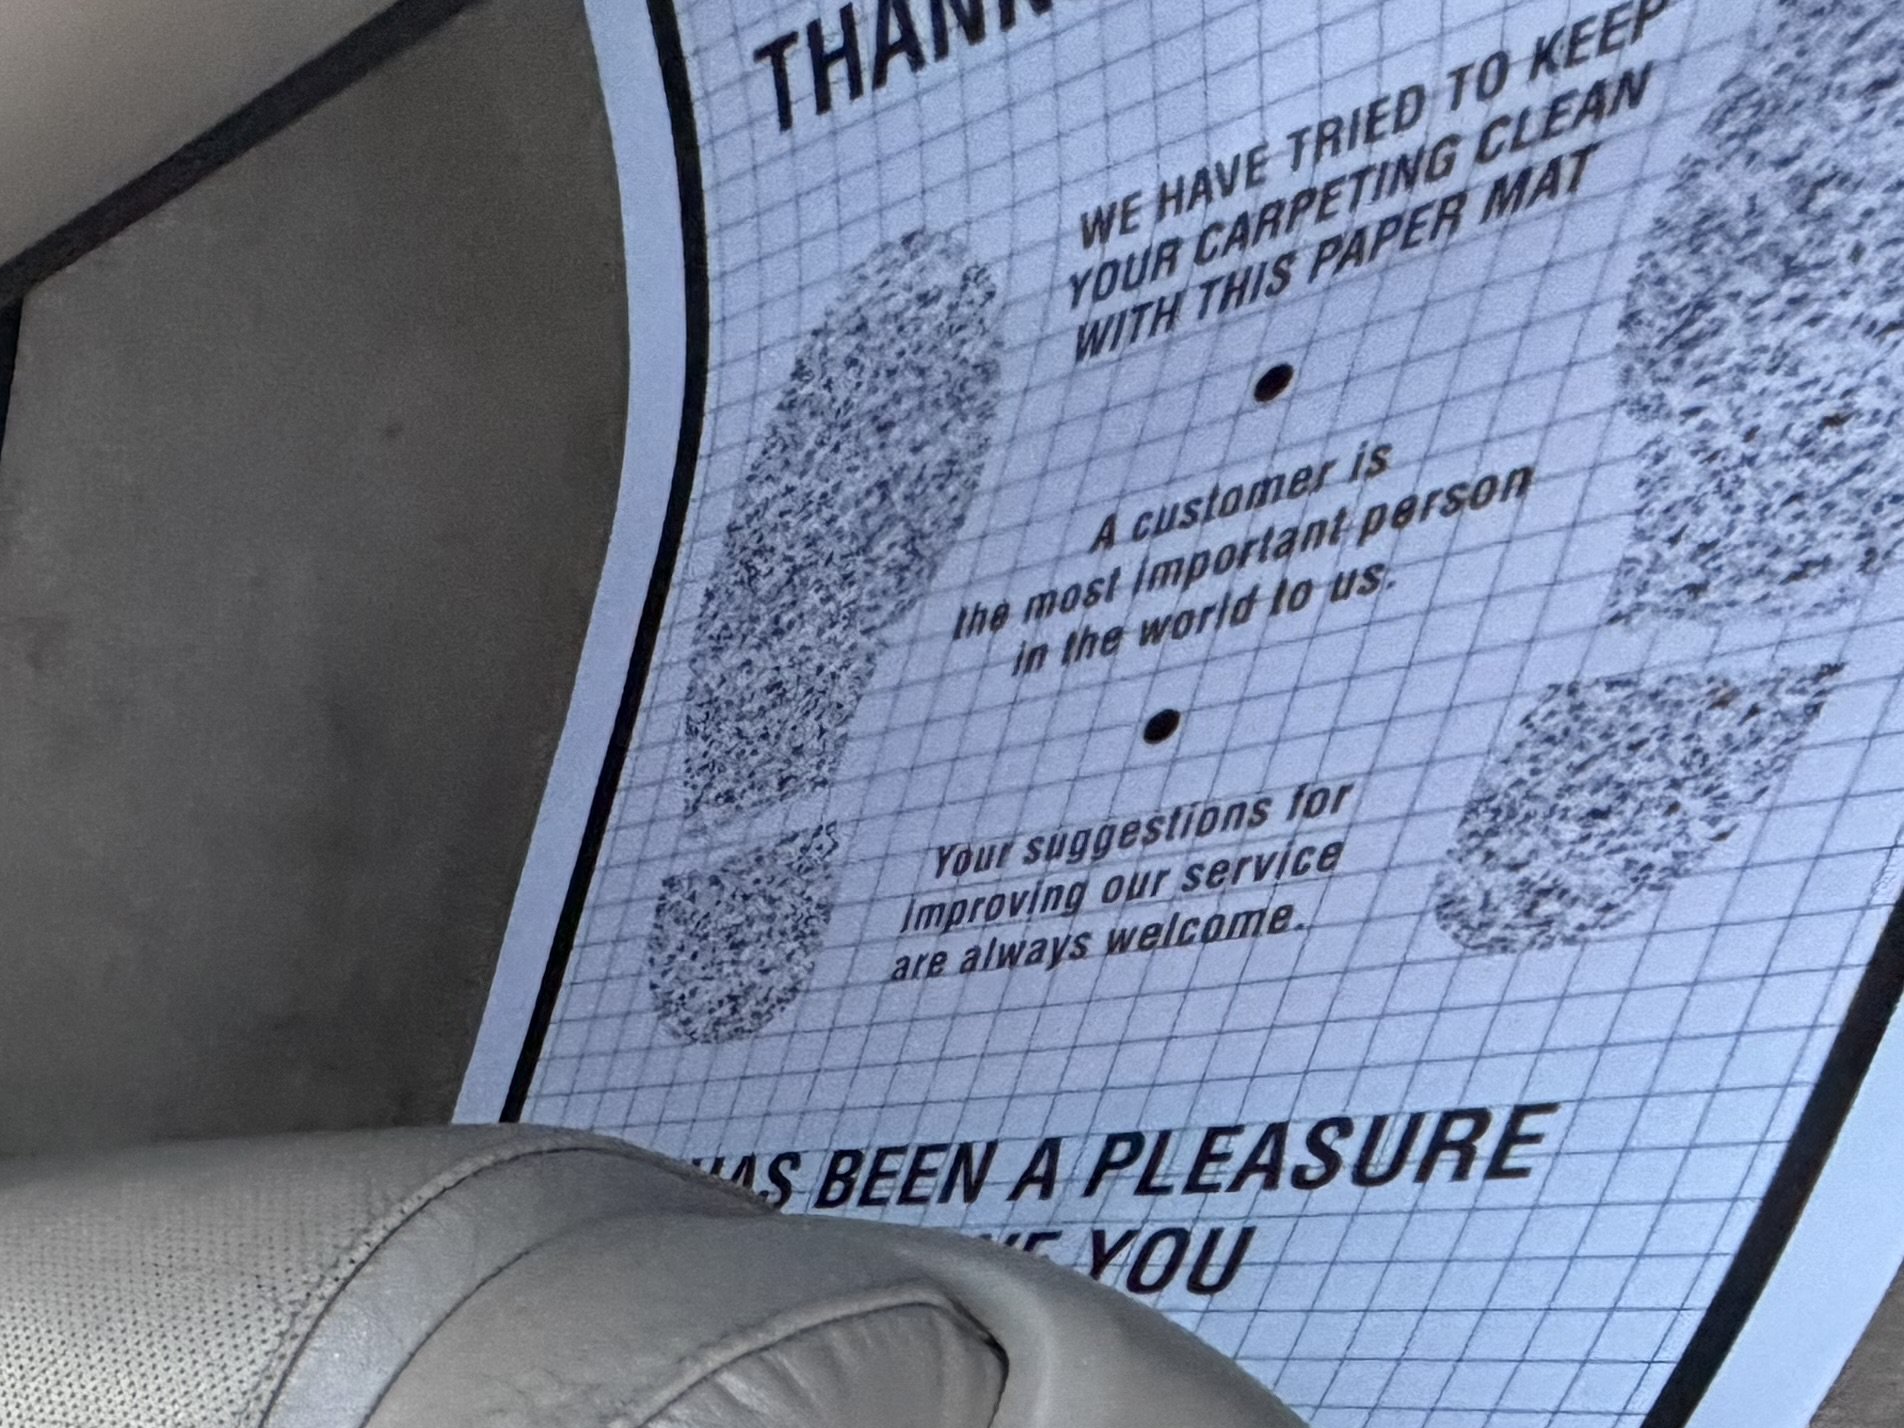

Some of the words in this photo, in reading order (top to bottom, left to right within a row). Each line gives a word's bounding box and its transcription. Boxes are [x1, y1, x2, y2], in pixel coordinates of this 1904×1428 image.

[1080, 191, 1143, 250] WE
[1156, 142, 1269, 223] HAVE
[1287, 84, 1426, 173] TRIED
[1447, 50, 1510, 112] TO
[1528, 0, 1670, 82] KEEP
[1068, 238, 1182, 310] YOUR
[1195, 133, 1462, 267] CARPETING
[1475, 61, 1654, 164] CLEAN
[1073, 292, 1187, 362] WITH
[1197, 250, 1294, 320] THIS
[1308, 192, 1468, 283] PAPER
[1479, 143, 1601, 224] MAT
[953, 598, 1010, 641] the
[1023, 567, 1121, 624] most
[1132, 506, 1348, 596] important
[1357, 464, 1536, 546] person
[1091, 513, 1116, 553] A
[1132, 459, 1336, 542] customer
[1349, 440, 1392, 480] is
[1011, 640, 1047, 677] in
[1061, 625, 1121, 666] the
[1139, 588, 1257, 648] world
[1269, 578, 1312, 617] to
[1330, 560, 1397, 598] us.
[900, 880, 1089, 934] improving
[1101, 868, 1171, 905] our
[1180, 840, 1346, 894] service
[936, 842, 1014, 880] Your
[1022, 797, 1273, 866] suggestions
[1286, 782, 1355, 823] for
[892, 950, 946, 983] are
[958, 930, 1094, 975] always
[1106, 902, 1307, 956] welcome.
[812, 1140, 999, 1209] BEEN
[1006, 1136, 1064, 1202] A
[1083, 1102, 1562, 1199] PLEASURE
[1088, 1226, 1257, 1297] YOU
